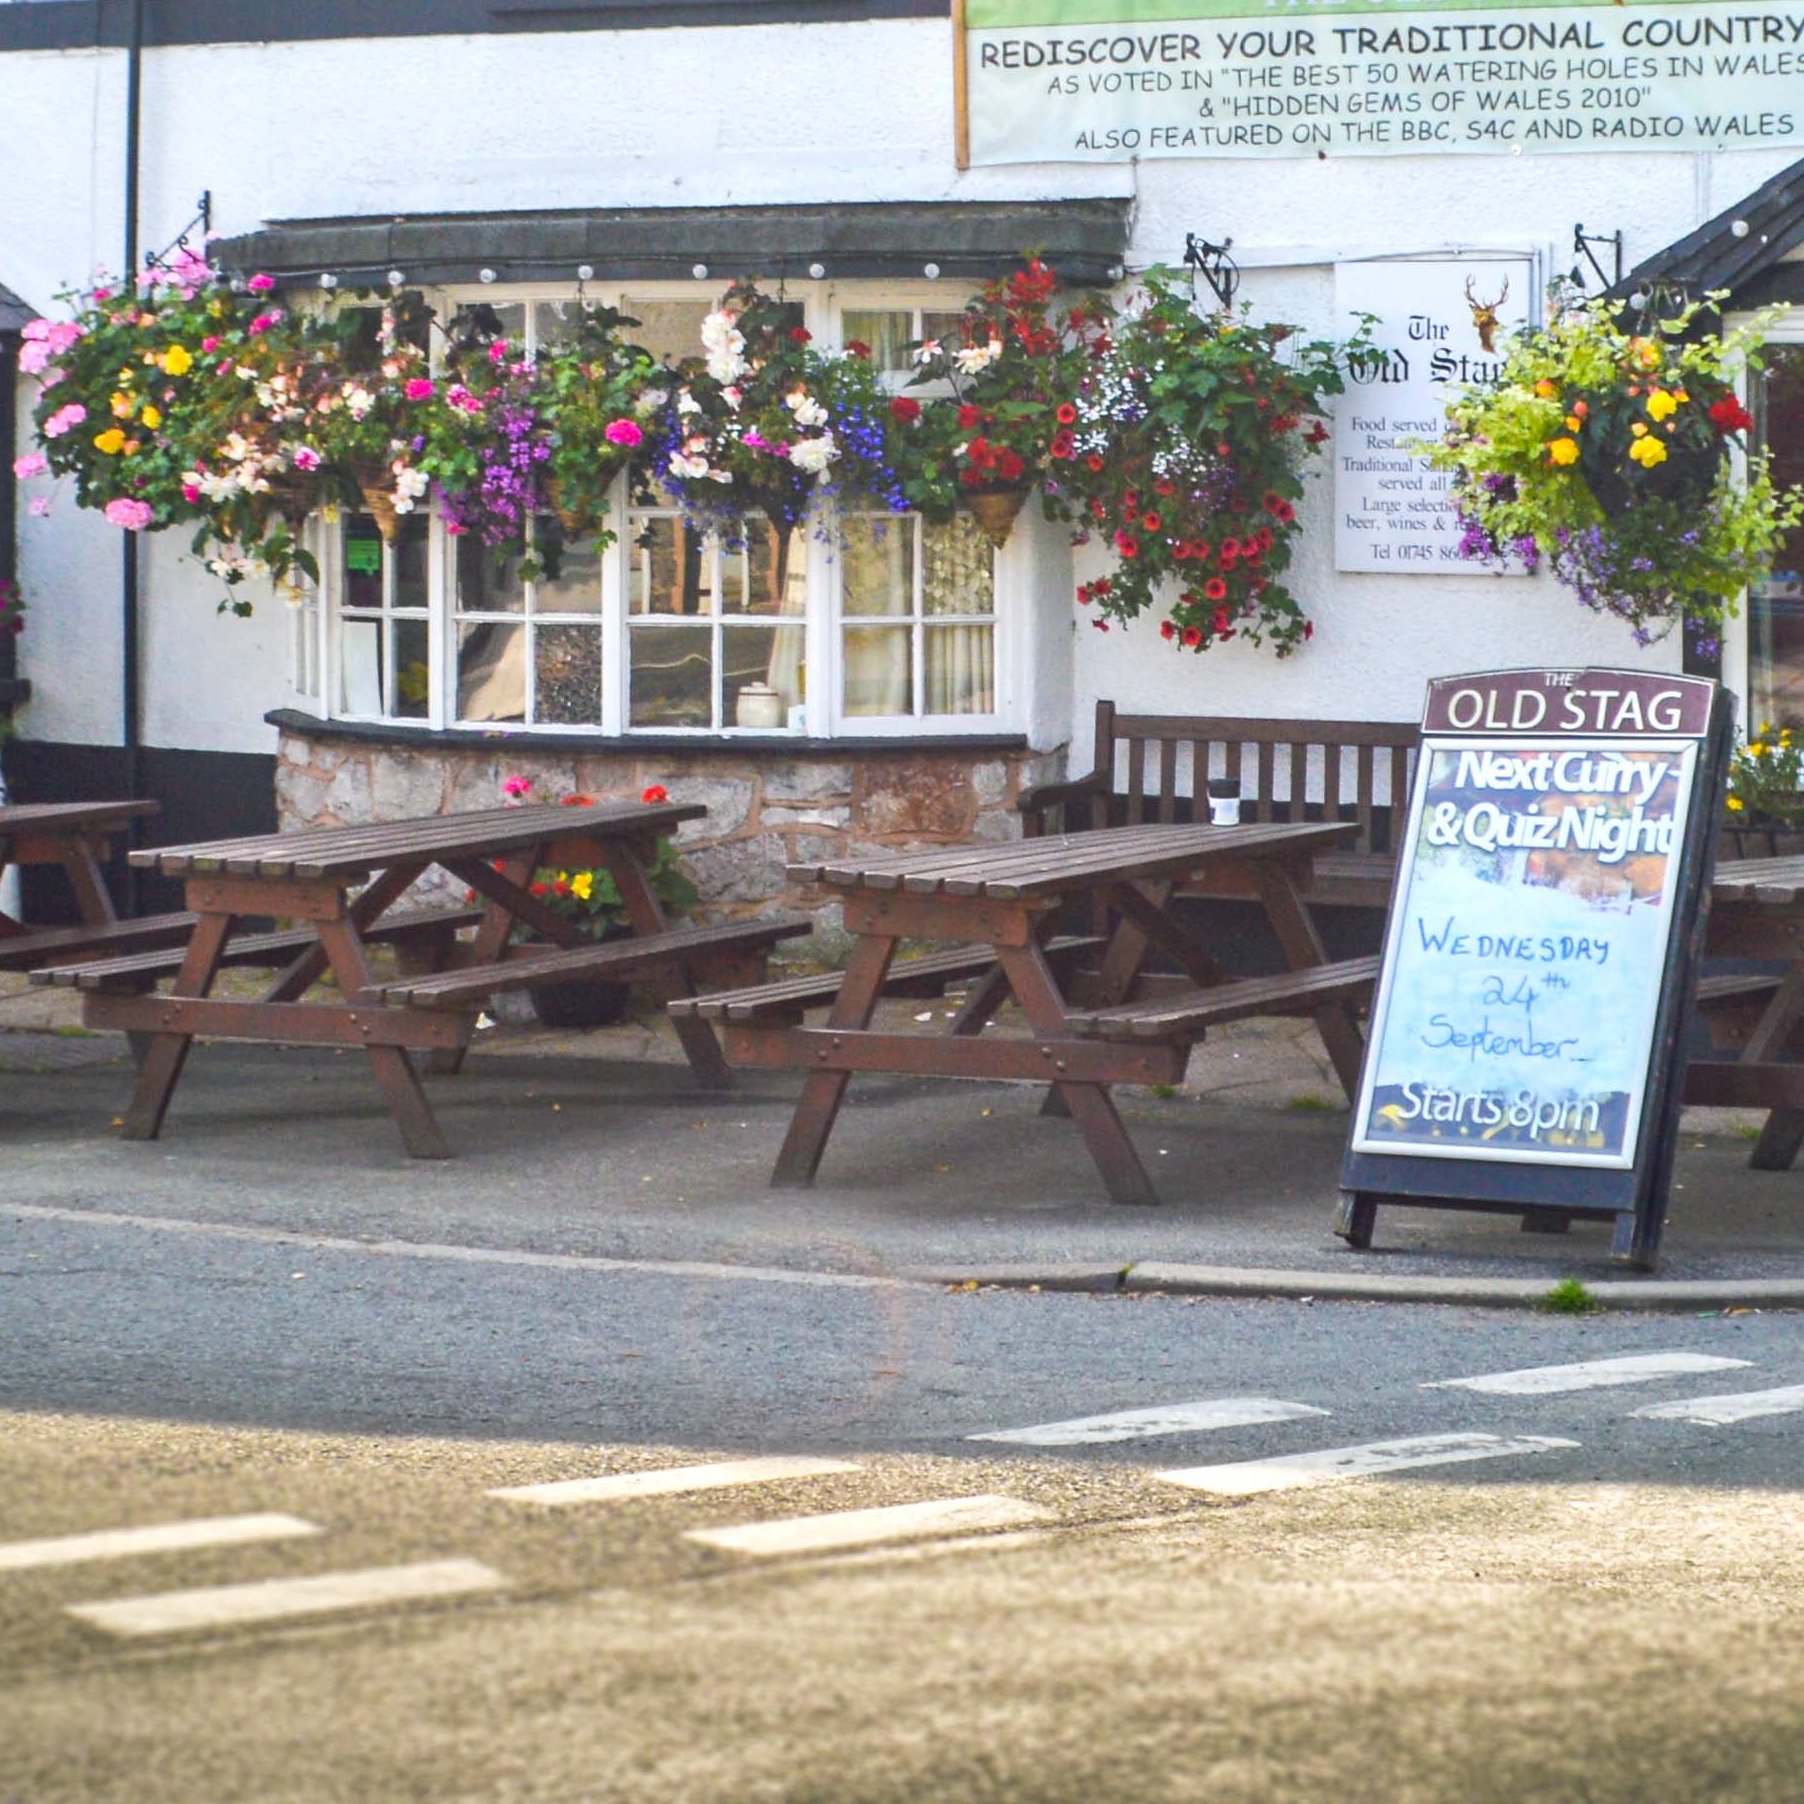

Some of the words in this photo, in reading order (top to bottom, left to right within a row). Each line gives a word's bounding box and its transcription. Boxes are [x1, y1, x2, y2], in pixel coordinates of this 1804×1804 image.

[982, 33, 1200, 68] REDISCOVER
[1218, 29, 1316, 60] YOUR
[1332, 20, 1604, 57] TRADITIONAL
[1048, 74, 1079, 95] AS
[1089, 71, 1172, 94] VOTED
[1180, 69, 1212, 90] IN
[1222, 66, 1282, 89] "THE
[1295, 63, 1358, 87] BEST
[1367, 62, 1398, 85] 50
[1406, 58, 1557, 84] WATERING
[1567, 55, 1658, 80] HOLES
[1668, 54, 1703, 77] IN
[1199, 98, 1214, 118] &
[1222, 94, 1338, 117] "HIDDEN
[1347, 91, 1421, 113] GEMS
[1431, 90, 1466, 111] OF
[1477, 88, 1571, 111] WALES
[1581, 85, 1651, 109] 2010"
[1075, 127, 1140, 150] ALSO
[1150, 124, 1283, 148] FEATURED
[1293, 122, 1331, 145] ON
[1340, 120, 1390, 142] THE
[1401, 118, 1457, 144] BBC,
[1467, 118, 1516, 141] S4C
[1524, 117, 1583, 140] AND
[1591, 115, 1683, 138] RADIO
[1695, 113, 1794, 137] WALES
[1407, 315, 1450, 344] The
[1348, 348, 1410, 384] Old
[1351, 417, 1386, 432] Food
[1392, 418, 1437, 433] served
[1342, 455, 1413, 473] Traditional
[1377, 476, 1423, 491] served
[1429, 476, 1447, 491] all
[1362, 496, 1402, 515] Large
[1387, 516, 1428, 531] wines
[1432, 516, 1446, 532] &
[1370, 543, 1391, 560] Tel
[1397, 544, 1433, 561] 01745
[1544, 672, 1574, 687] THE
[1447, 689, 1547, 730] OLD
[1559, 690, 1683, 731] STAG
[1454, 750, 1554, 791] Next
[1553, 750, 1669, 805] Curry
[1427, 801, 1463, 846] &
[1463, 802, 1559, 853] Quiz
[1557, 804, 1677, 863] Night
[1418, 915, 1610, 965] WEDNESDAY
[1421, 1013, 1579, 1063] September
[1397, 1081, 1504, 1126] Starts
[1508, 1094, 1600, 1139] 8pm
